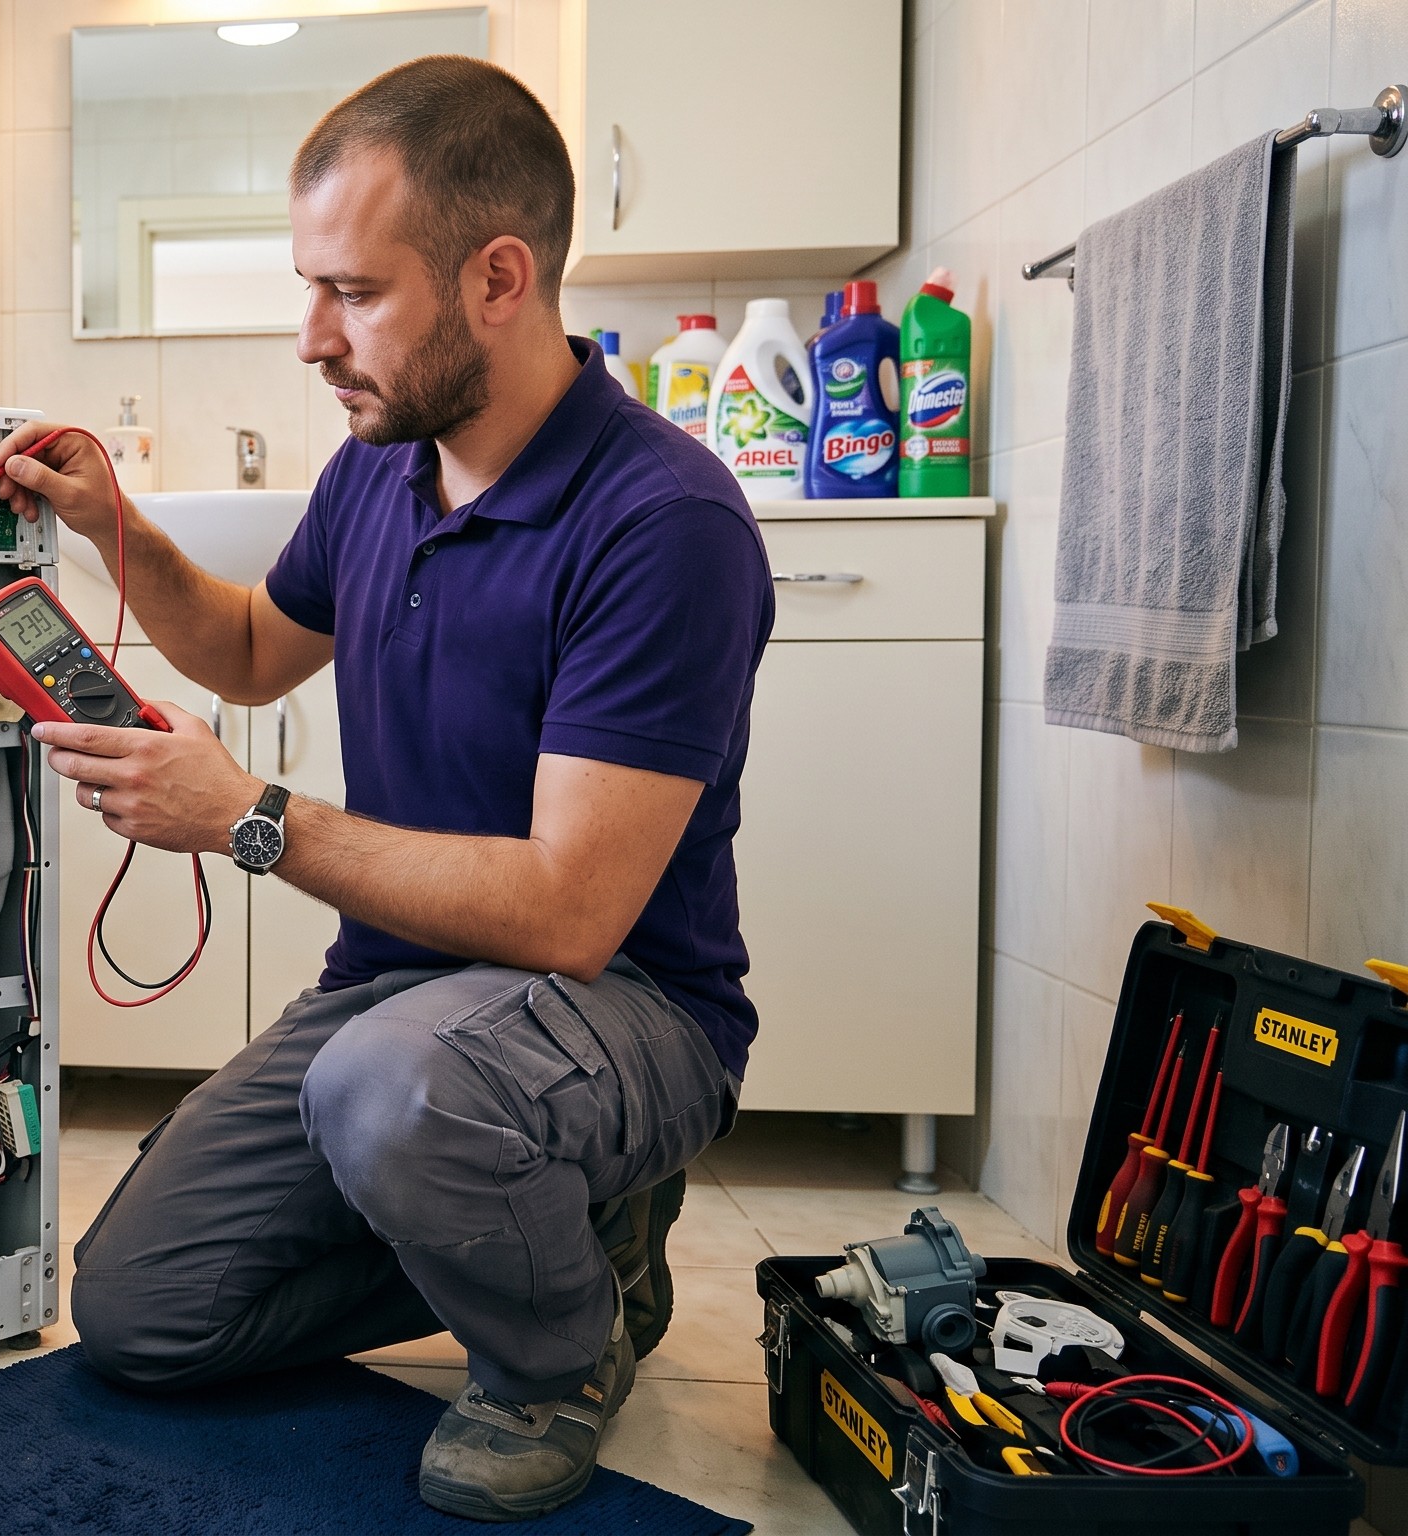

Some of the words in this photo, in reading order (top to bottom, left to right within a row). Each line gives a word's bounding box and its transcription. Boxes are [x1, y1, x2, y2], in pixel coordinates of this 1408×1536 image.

[735, 450, 798, 467] ARIEL
[826, 432, 894, 461] Bingo
[1260, 1017, 1332, 1056] STANLEY
[825, 1381, 888, 1465] STANLEY
